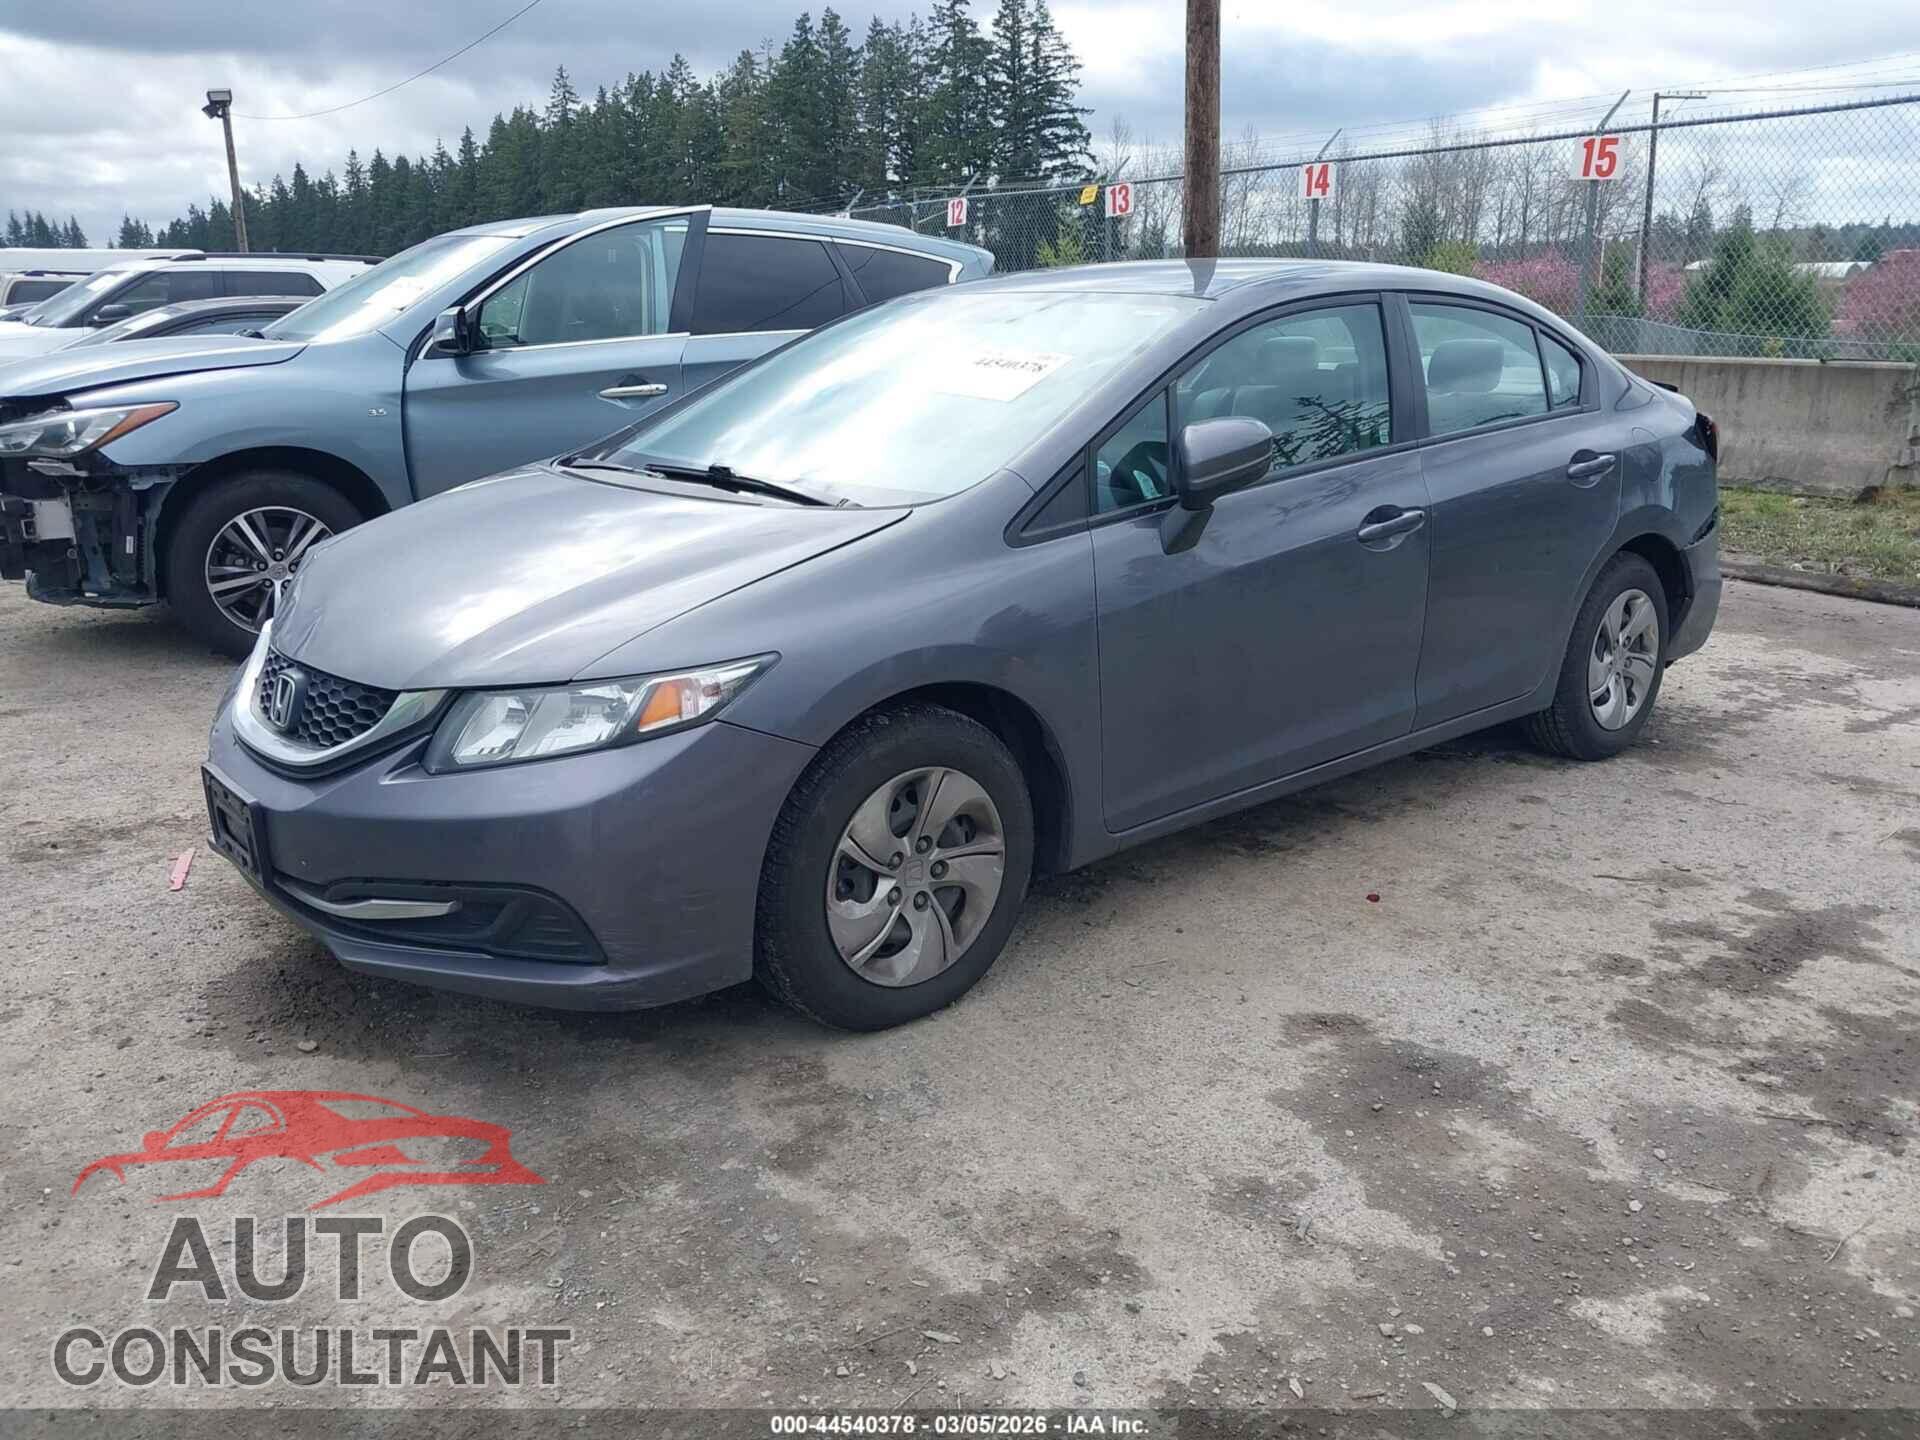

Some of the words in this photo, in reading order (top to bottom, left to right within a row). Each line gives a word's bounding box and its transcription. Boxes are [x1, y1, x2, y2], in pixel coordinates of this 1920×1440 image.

[1582, 137, 1619, 178] 15
[1305, 164, 1330, 197] 14
[950, 200, 964, 224] 12
[1110, 184, 1130, 213] 13
